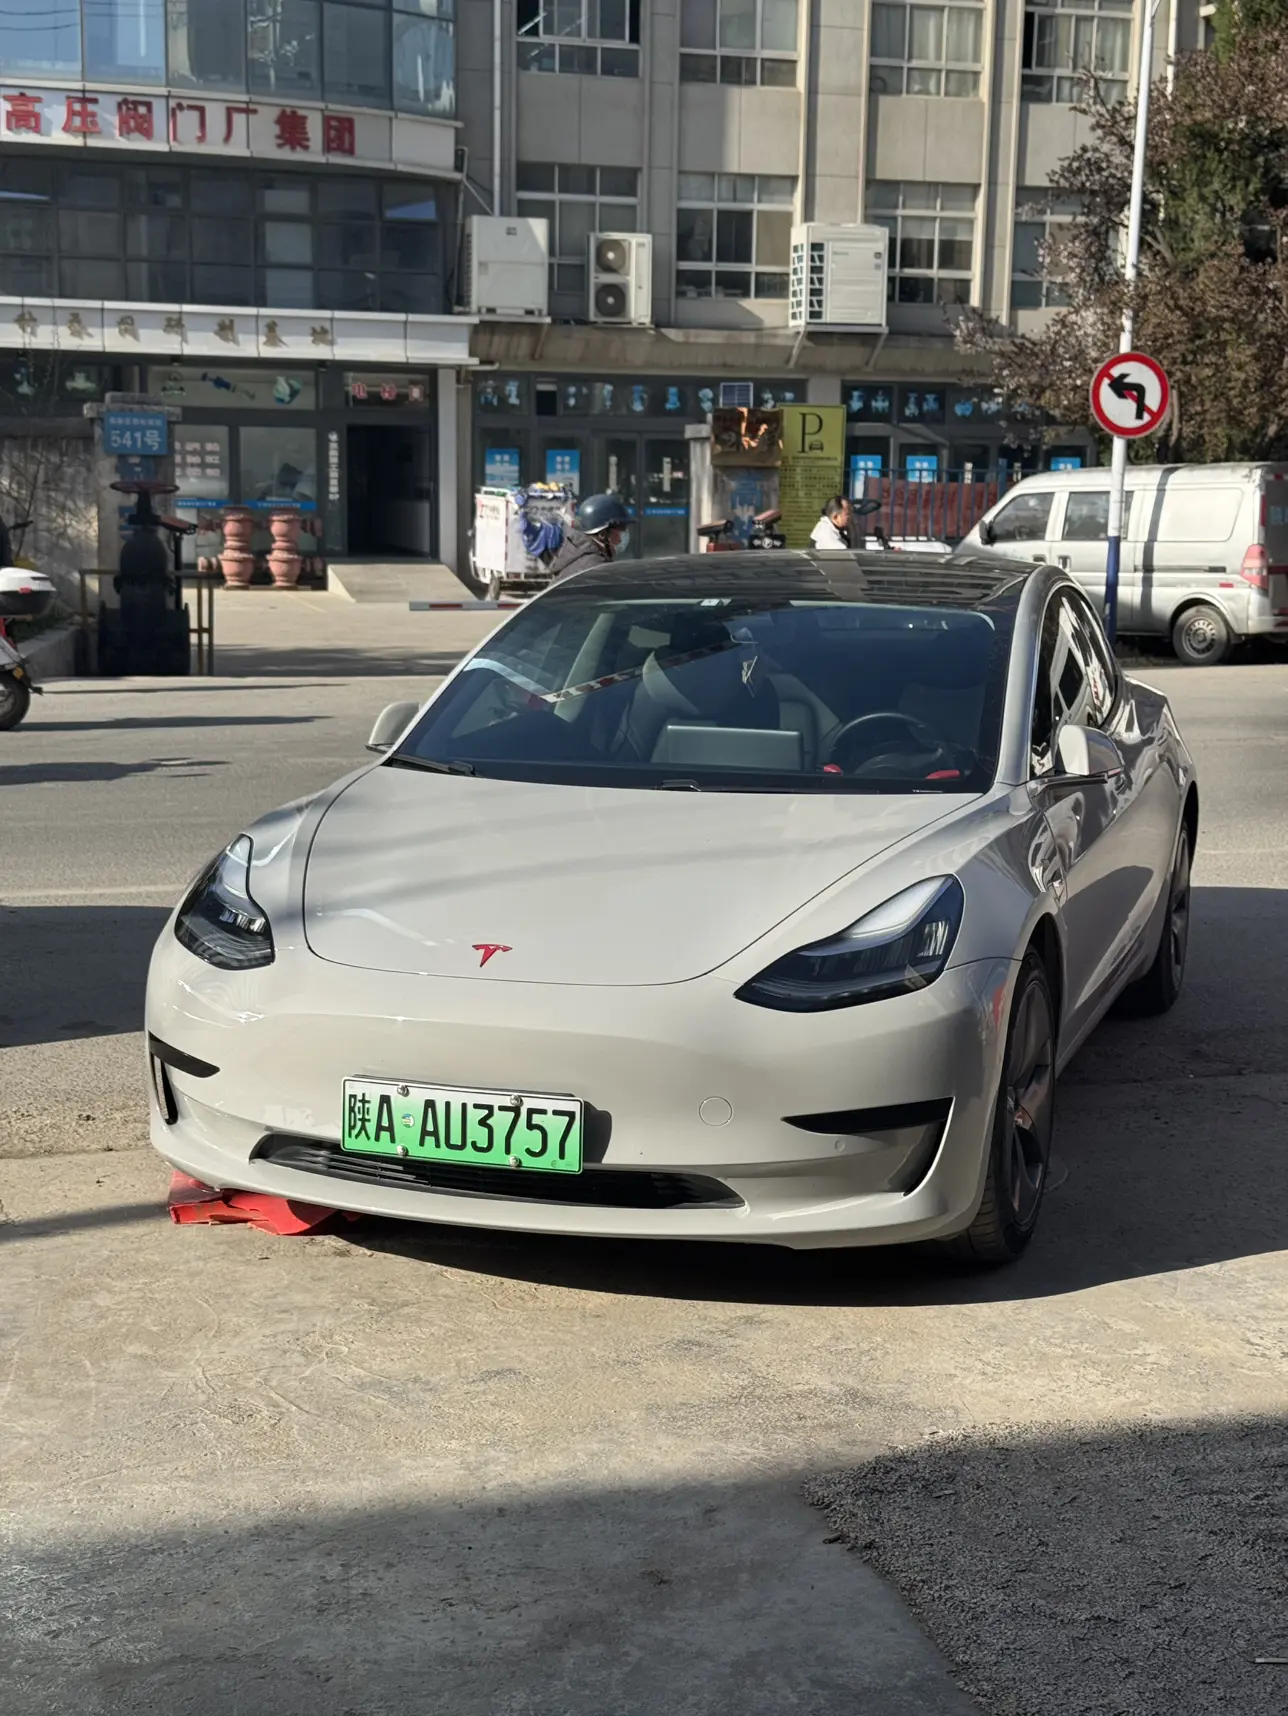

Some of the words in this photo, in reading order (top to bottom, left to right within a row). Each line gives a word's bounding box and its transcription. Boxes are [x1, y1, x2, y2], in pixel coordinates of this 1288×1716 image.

[2, 92, 356, 156] 高压阀门厂集团
[110, 430, 161, 450] 541号
[797, 412, 823, 454] P
[348, 1092, 396, 1144] 陕A
[418, 1098, 576, 1160] AU3757
